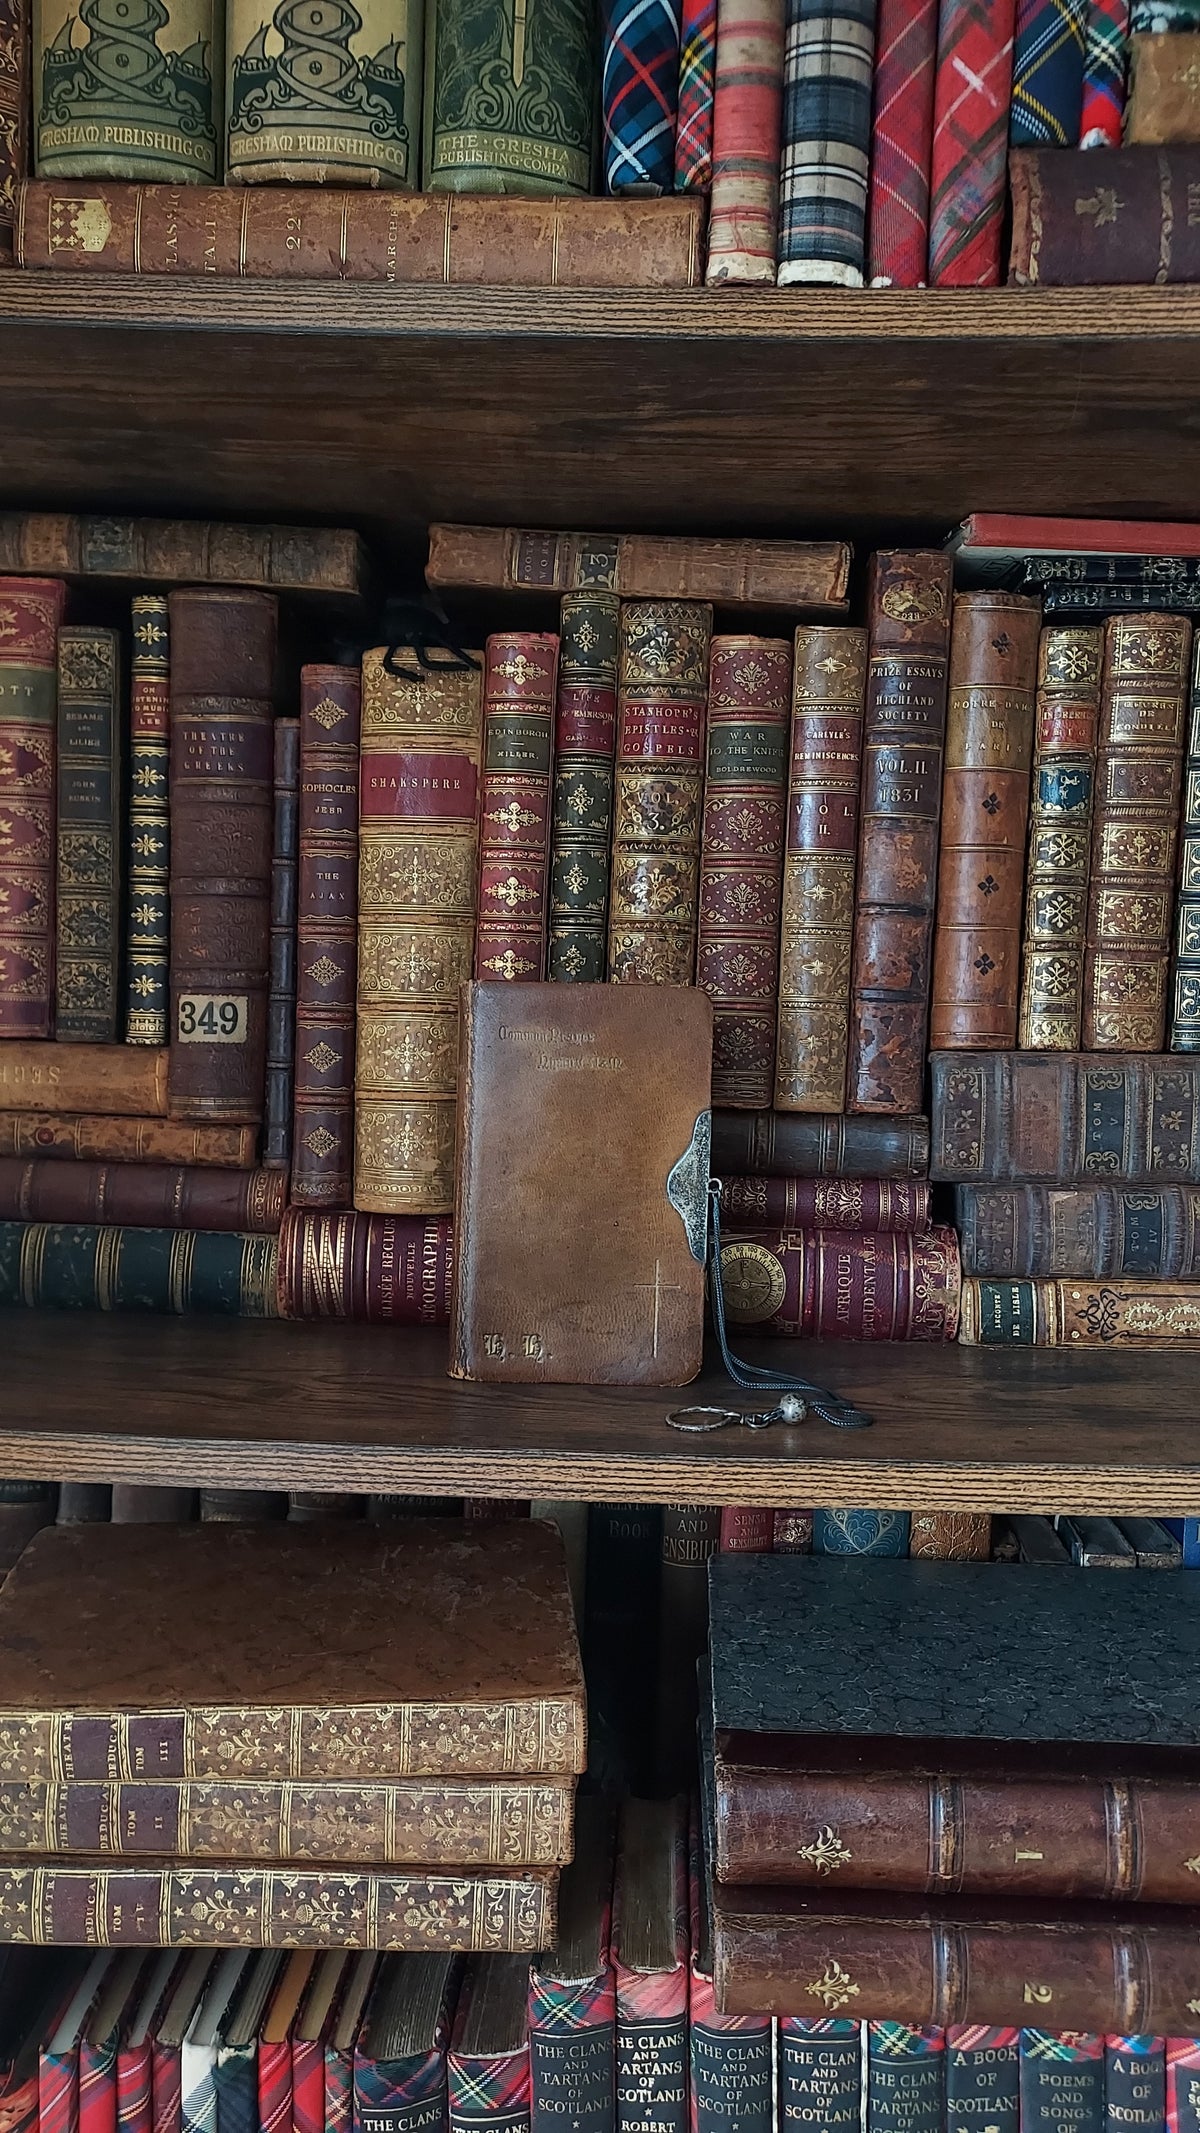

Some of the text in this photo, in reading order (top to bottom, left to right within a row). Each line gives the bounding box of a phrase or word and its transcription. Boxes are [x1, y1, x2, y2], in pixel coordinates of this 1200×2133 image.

[40, 123, 212, 162] GRESHAM PUBLISHING CO
[439, 134, 584, 165] THE GRESHA
[231, 135, 404, 165] GRESHAM PUBLISHING CO
[589, 552, 609, 568] 3
[870, 666, 944, 679] PRIZE ESSAYS
[142, 686, 156, 694] ON
[899, 681, 913, 691] OF
[143, 704, 168, 712] MUSI
[875, 696, 935, 706] HIGHLAND
[625, 706, 699, 720] STANHOPE'S
[878, 710, 929, 722] SOCIETY
[1139, 710, 1156, 718] DE
[488, 728, 549, 739] EDINBURGH
[729, 731, 766, 741] WAR
[806, 728, 851, 740] CARLYLE'S
[211, 746, 235, 757] THE
[624, 742, 694, 756] GOSPELS
[727, 746, 748, 755] THE
[716, 766, 777, 774] BOLDREWOOD
[302, 783, 357, 794] SOPHOCLES
[370, 777, 461, 790] SHAKSPERE
[637, 792, 680, 805] VOL.
[879, 788, 920, 803] 1831
[316, 872, 340, 881] THE
[310, 892, 345, 901] AJAX
[180, 1000, 239, 1035] 349
[1092, 1102, 1102, 1141] TOM
[1110, 1118, 1119, 1126] V
[1130, 1216, 1140, 1252] TOM
[382, 1218, 396, 1269] RECLUS
[405, 1241, 416, 1300] NOUVELLE
[836, 1254, 853, 1324] AFRIQUE
[994, 1294, 1002, 1329] LECONTE
[1011, 1286, 1021, 1337] DE LISLE
[677, 1519, 708, 1533] AND
[135, 1746, 145, 1771] TOM
[159, 1741, 169, 1762] III
[127, 1809, 137, 1837] TOM
[154, 1816, 163, 1830] II
[1015, 1848, 1044, 1864] 1
[113, 1904, 122, 1933] TOM
[1024, 1980, 1053, 2004] 2
[638, 2031, 685, 2050] CLANS
[535, 2042, 565, 2059] THE
[632, 2051, 659, 2061] AND
[695, 2039, 770, 2061] THE CLANS
[784, 2048, 858, 2066] THE CLAN
[953, 2046, 1018, 2066] A BOOK
[563, 2060, 589, 2070] AND
[617, 2060, 683, 2076] ARTANS
[721, 2063, 747, 2072] AND
[1113, 2058, 1164, 2076] A BOO
[540, 2068, 610, 2086] TARTANS
[699, 2068, 769, 2088] TARTANS
[811, 2068, 838, 2078] AND
[976, 2072, 998, 2086] OF
[1039, 2073, 1095, 2087] POEMS
[638, 2077, 656, 2088] OF
[788, 2077, 859, 2095] TARTANS
[568, 2088, 583, 2099] OF
[726, 2090, 743, 2100] OF
[893, 2090, 920, 2100] AND
[1051, 2092, 1083, 2104] AND
[1132, 2085, 1153, 2099] OF
[538, 2095, 612, 2114] SCOTLAND
[698, 2094, 770, 2116] SCOTLAND
[816, 2097, 833, 2107] OF
[871, 2098, 940, 2116] TARTANS
[364, 2106, 442, 2132] THE CLANS
[785, 2104, 860, 2123] SCOTLAND
[1040, 2106, 1093, 2118] SONGS
[1108, 2103, 1164, 2123] SCOTLAN
[621, 2119, 676, 2133] ROBERT
[897, 2118, 914, 2128] OF
[1057, 2124, 1078, 2133] OF
